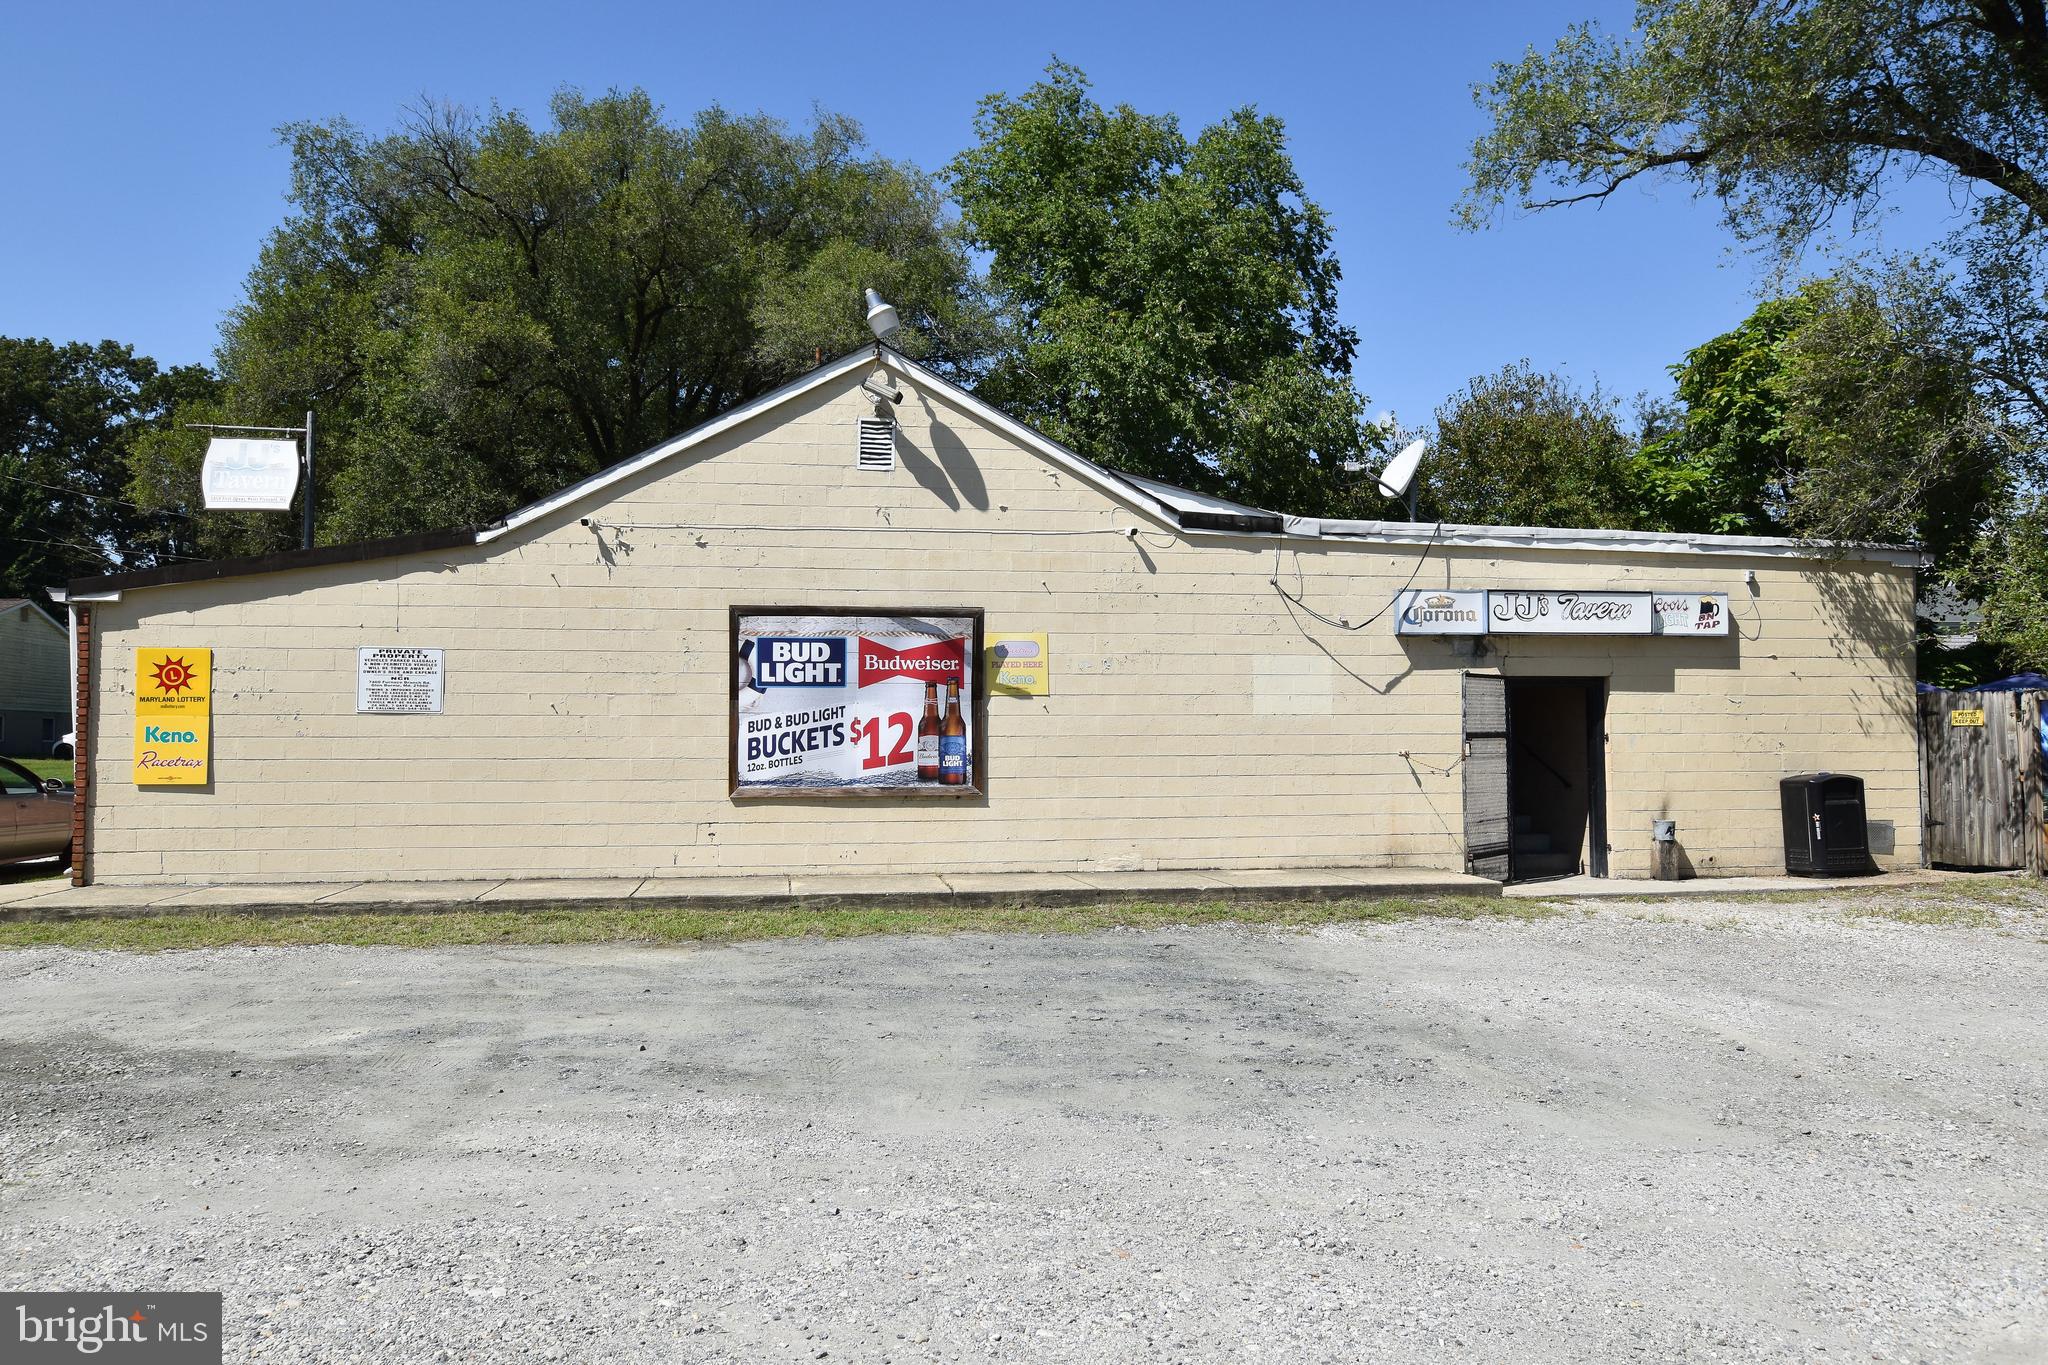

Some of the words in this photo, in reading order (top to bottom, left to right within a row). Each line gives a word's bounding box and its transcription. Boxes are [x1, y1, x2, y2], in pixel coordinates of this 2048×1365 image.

[214, 471, 287, 490] Tavern
[1493, 593, 1549, 622] JJ's
[1557, 593, 1632, 622] Tavern
[1654, 598, 1689, 614] Coors
[1403, 605, 1478, 627] Corona
[1655, 613, 1689, 630] LIGHT
[1695, 620, 1721, 630] TAP
[772, 642, 830, 662] BUD
[762, 662, 842, 683] LIGHT
[864, 654, 959, 672] Budweiser
[748, 718, 772, 733] BUD
[775, 716, 782, 729] &
[785, 712, 809, 727] BUD
[812, 706, 846, 723] LIGHT
[748, 722, 845, 761] BUCKETS
[137, 750, 203, 769] Racetrax
[747, 762, 767, 772] 12oz.
[768, 754, 803, 769] BOTTLES
